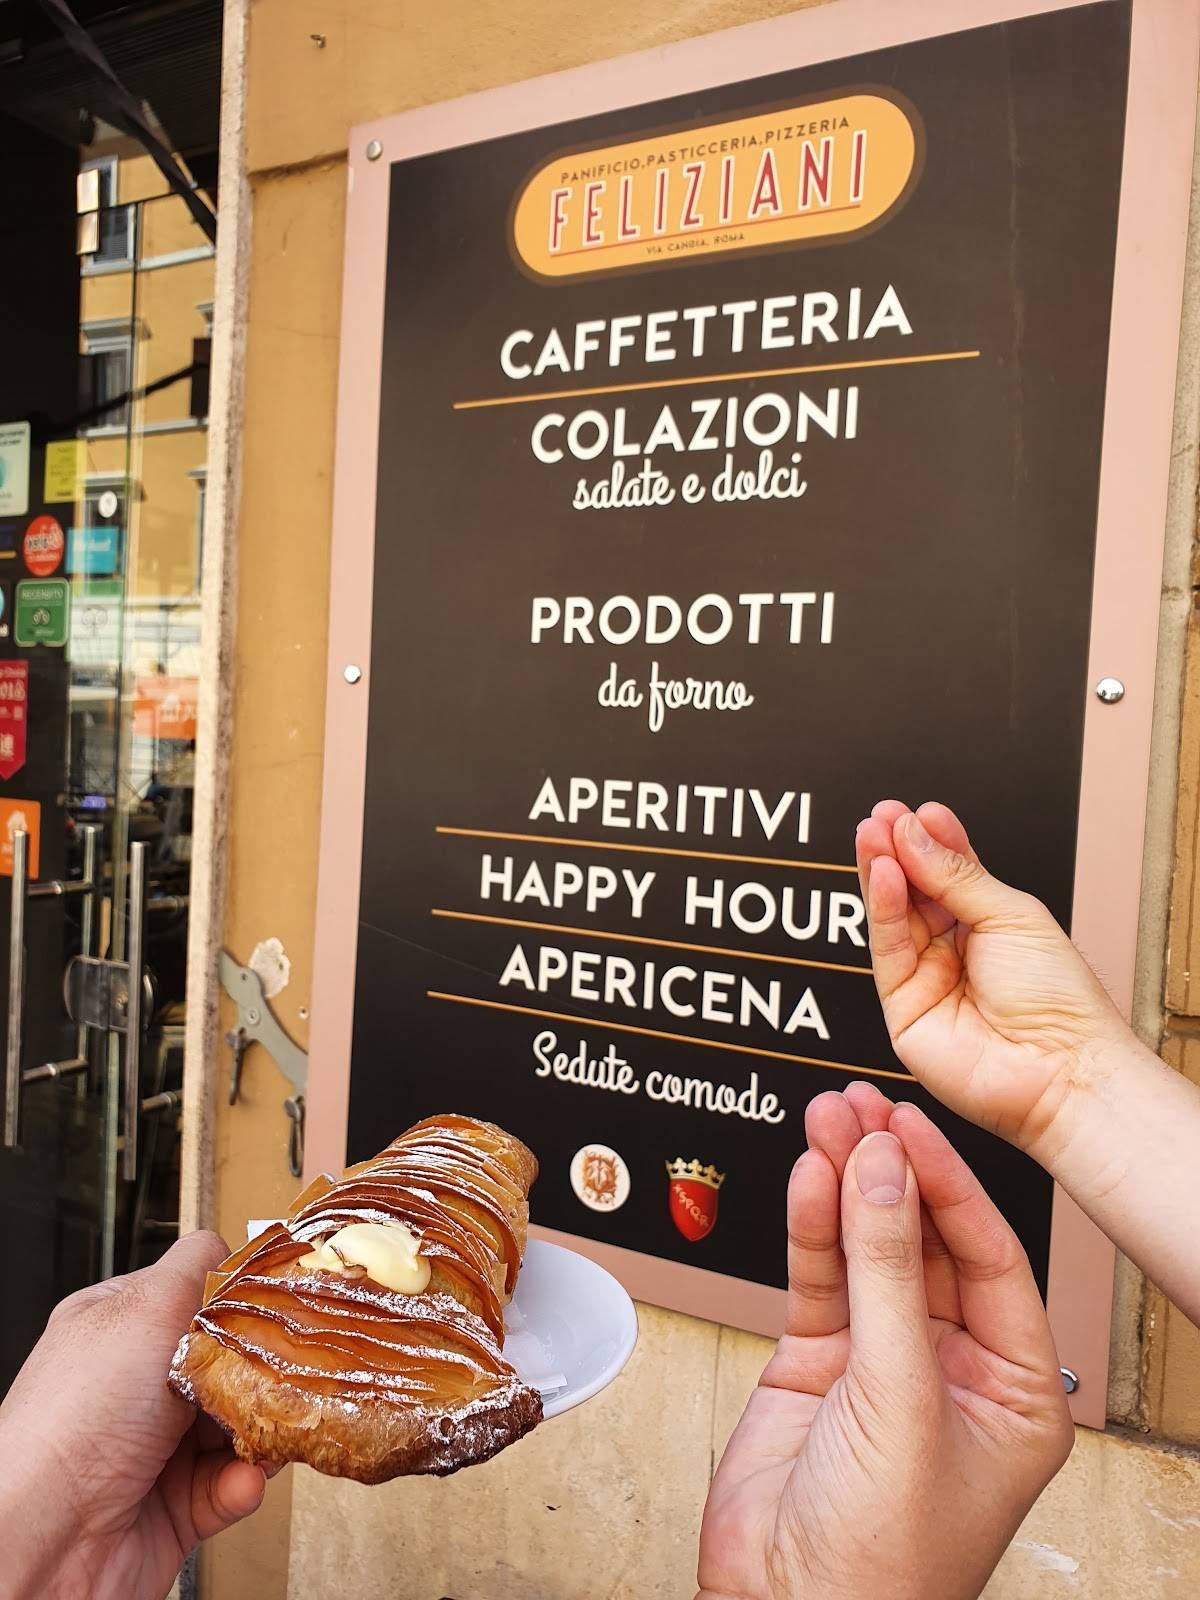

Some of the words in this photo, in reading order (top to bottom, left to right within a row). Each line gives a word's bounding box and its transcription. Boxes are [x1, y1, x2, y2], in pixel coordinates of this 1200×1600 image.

[548, 129, 868, 254] FELIZIANI
[500, 284, 913, 380] CAFFETTERIA
[531, 386, 859, 464] COLAZIONI
[572, 457, 676, 511] salate
[681, 473, 706, 504] e
[711, 448, 808, 502] dolci
[530, 591, 835, 645] PRODOTTI
[597, 661, 644, 708] da
[648, 661, 755, 733] forno
[528, 777, 811, 843] APERITIVI
[480, 854, 656, 920] HAPPY
[684, 876, 867, 948] HOUR
[499, 944, 831, 1041] APERICENA
[532, 1030, 640, 1094] Sedute
[645, 1070, 786, 1124] comode
